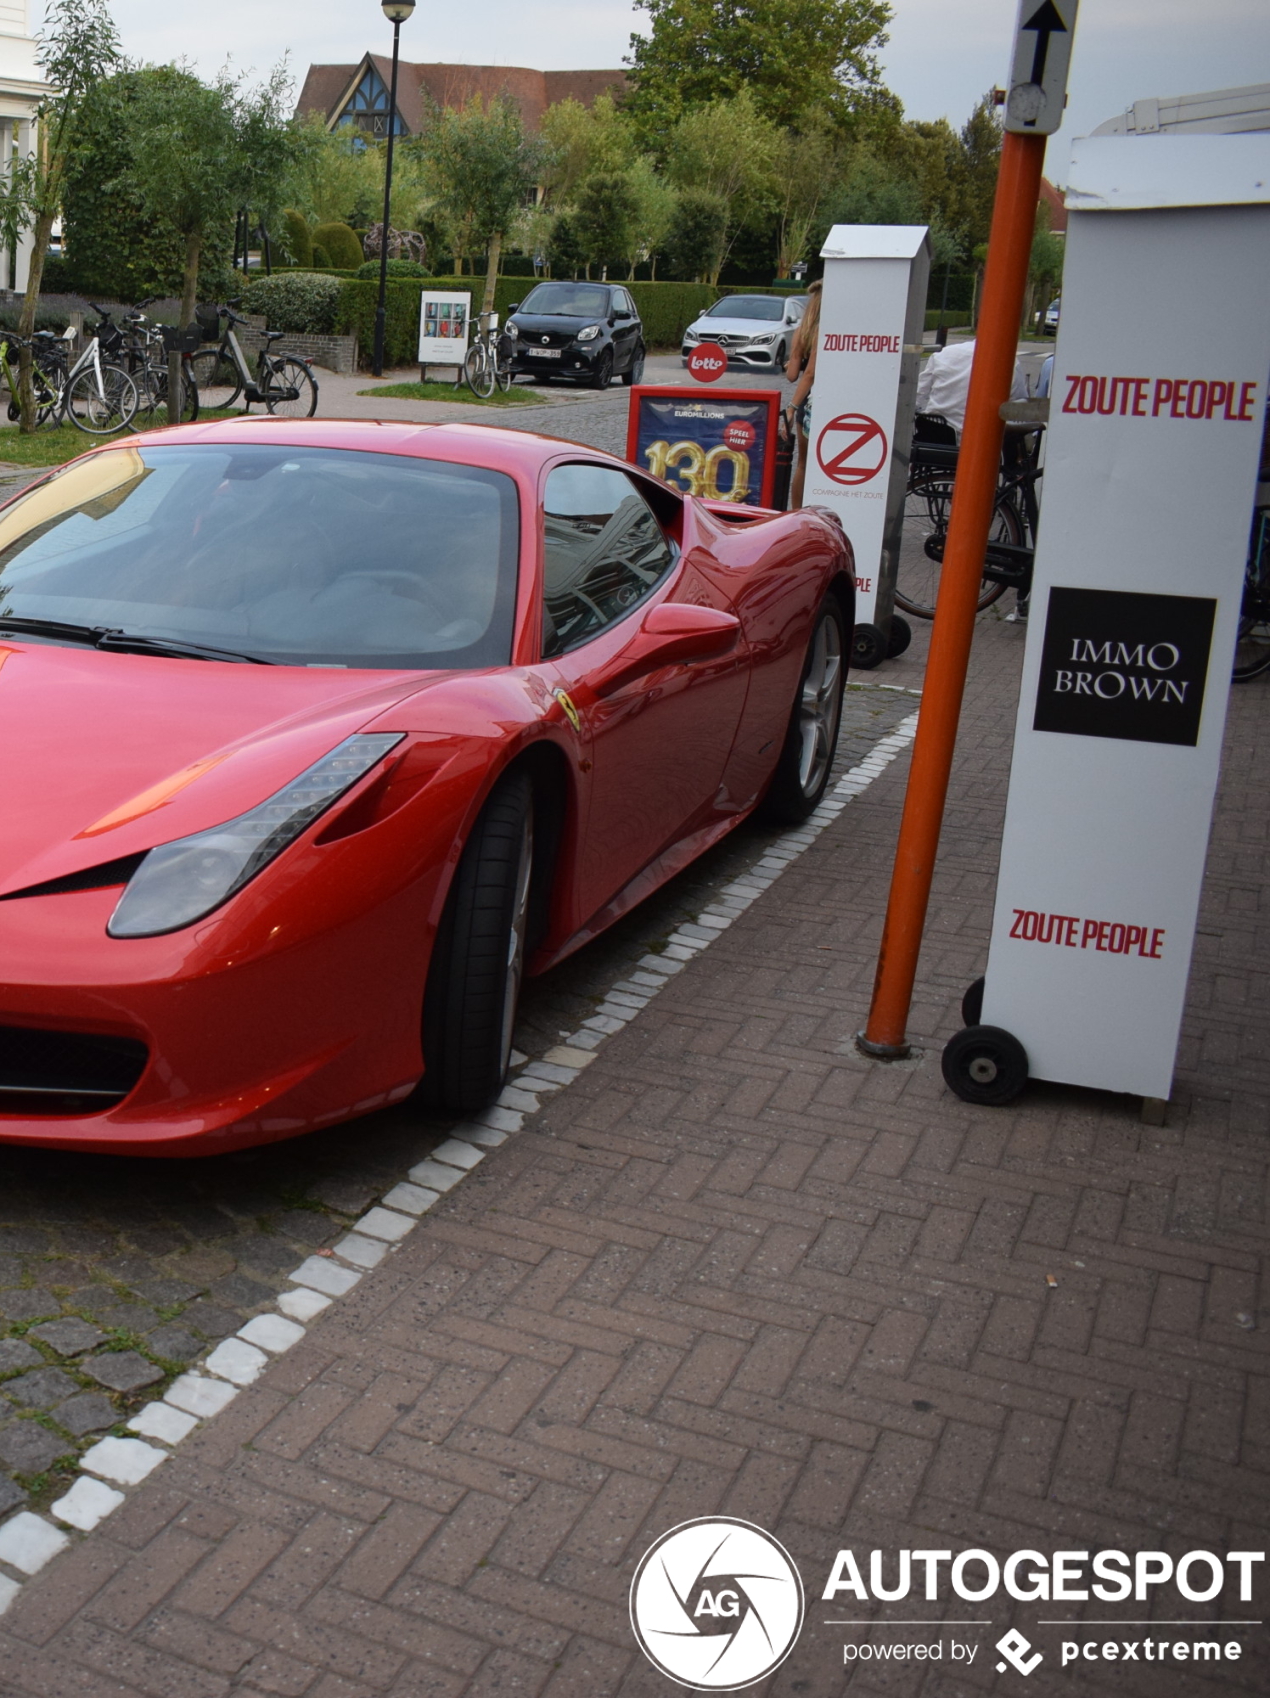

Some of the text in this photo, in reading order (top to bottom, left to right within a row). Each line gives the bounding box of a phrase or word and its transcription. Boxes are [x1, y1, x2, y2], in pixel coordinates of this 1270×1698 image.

[823, 334, 900, 353] ZOUTE PEOPLE
[1062, 375, 1257, 421] ZOUTE PEOPLE
[674, 410, 725, 419] EUROMILLIONS
[729, 428, 750, 438] SPEEL
[729, 436, 747, 445] HIER
[645, 440, 750, 501] 130
[812, 488, 849, 497] COMPAGNIE
[850, 490, 862, 498] HET
[1069, 638, 1180, 671] IMMO
[1053, 670, 1189, 704] BROWN
[1009, 908, 1165, 959] ZOUTE PEOPLE
